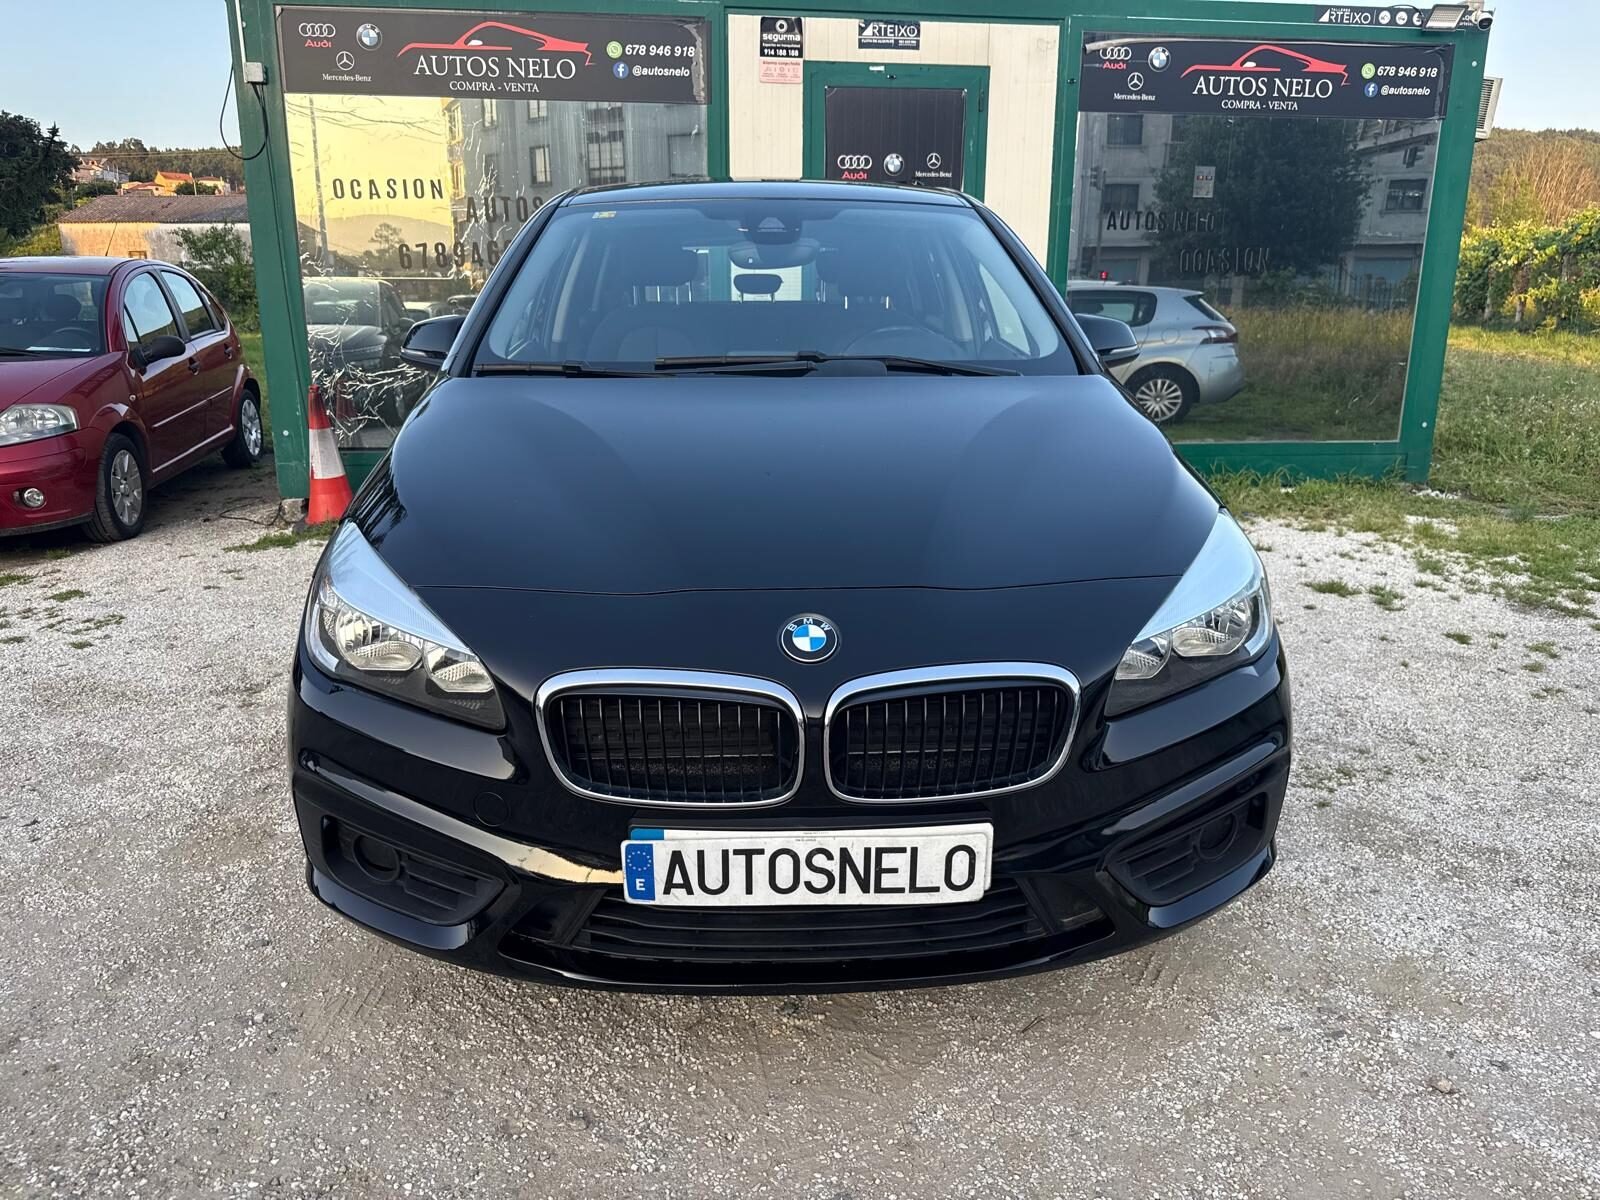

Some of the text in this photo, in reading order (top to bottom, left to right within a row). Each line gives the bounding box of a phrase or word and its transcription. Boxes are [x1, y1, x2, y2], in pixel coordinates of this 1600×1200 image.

[304, 39, 332, 48] Audi
[762, 33, 800, 42] segurma
[625, 44, 695, 57] 678 946 918
[413, 55, 576, 80] AUTOS NELO
[632, 65, 690, 77] @autosnelo
[1103, 62, 1127, 70] Audi
[1377, 65, 1438, 78] 678 946 918
[322, 73, 372, 82] Mercedes-Benz
[449, 81, 496, 92] COMPRA
[503, 82, 539, 93] VENTA
[1192, 75, 1333, 98] AUTOS NELO
[1380, 85, 1430, 96] @autosnelo
[1113, 93, 1156, 101] Mercedes-Benz
[1221, 99, 1261, 110] COMPRA
[1268, 101, 1298, 111] VENTA
[842, 171, 867, 180] Audi
[332, 178, 444, 200] OCASION
[466, 196, 544, 224] AUTOS
[1106, 211, 1167, 231] AUTOS
[399, 240, 512, 270] 678946
[786, 618, 832, 632] BMW
[635, 844, 977, 897] E AUTOSNELO
